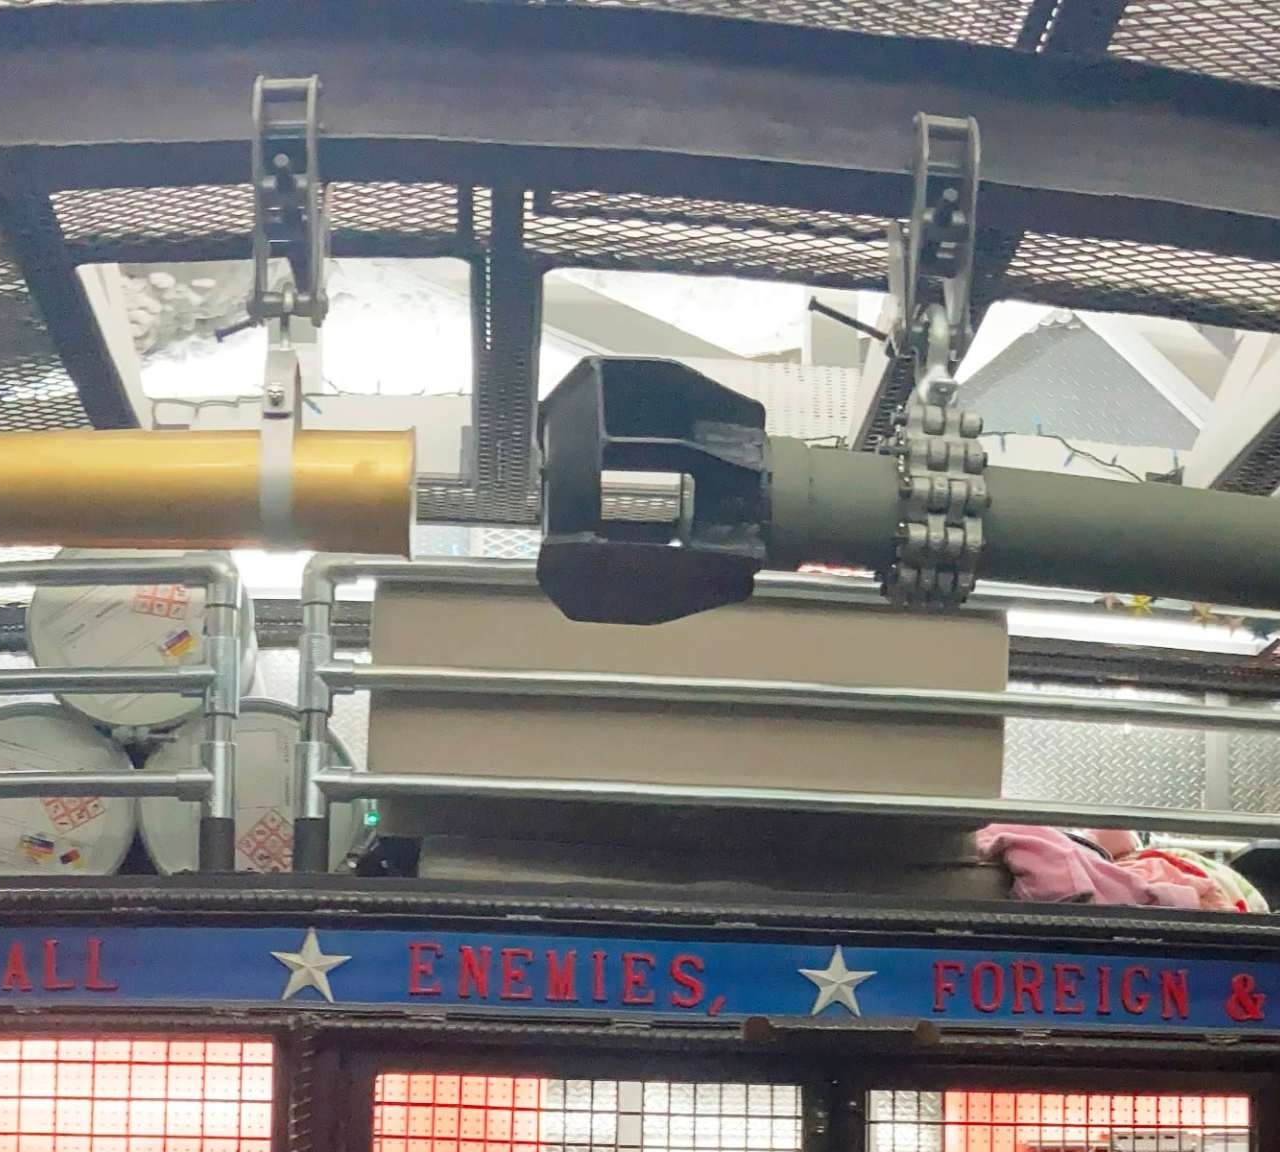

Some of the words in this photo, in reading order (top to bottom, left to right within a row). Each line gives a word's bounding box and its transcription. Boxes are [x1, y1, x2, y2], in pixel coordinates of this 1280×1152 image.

[1, 938, 119, 992] ALL
[408, 941, 727, 1016] ENEMIES,
[932, 961, 1189, 1019] FOREIGN
[1225, 972, 1265, 1023] &
